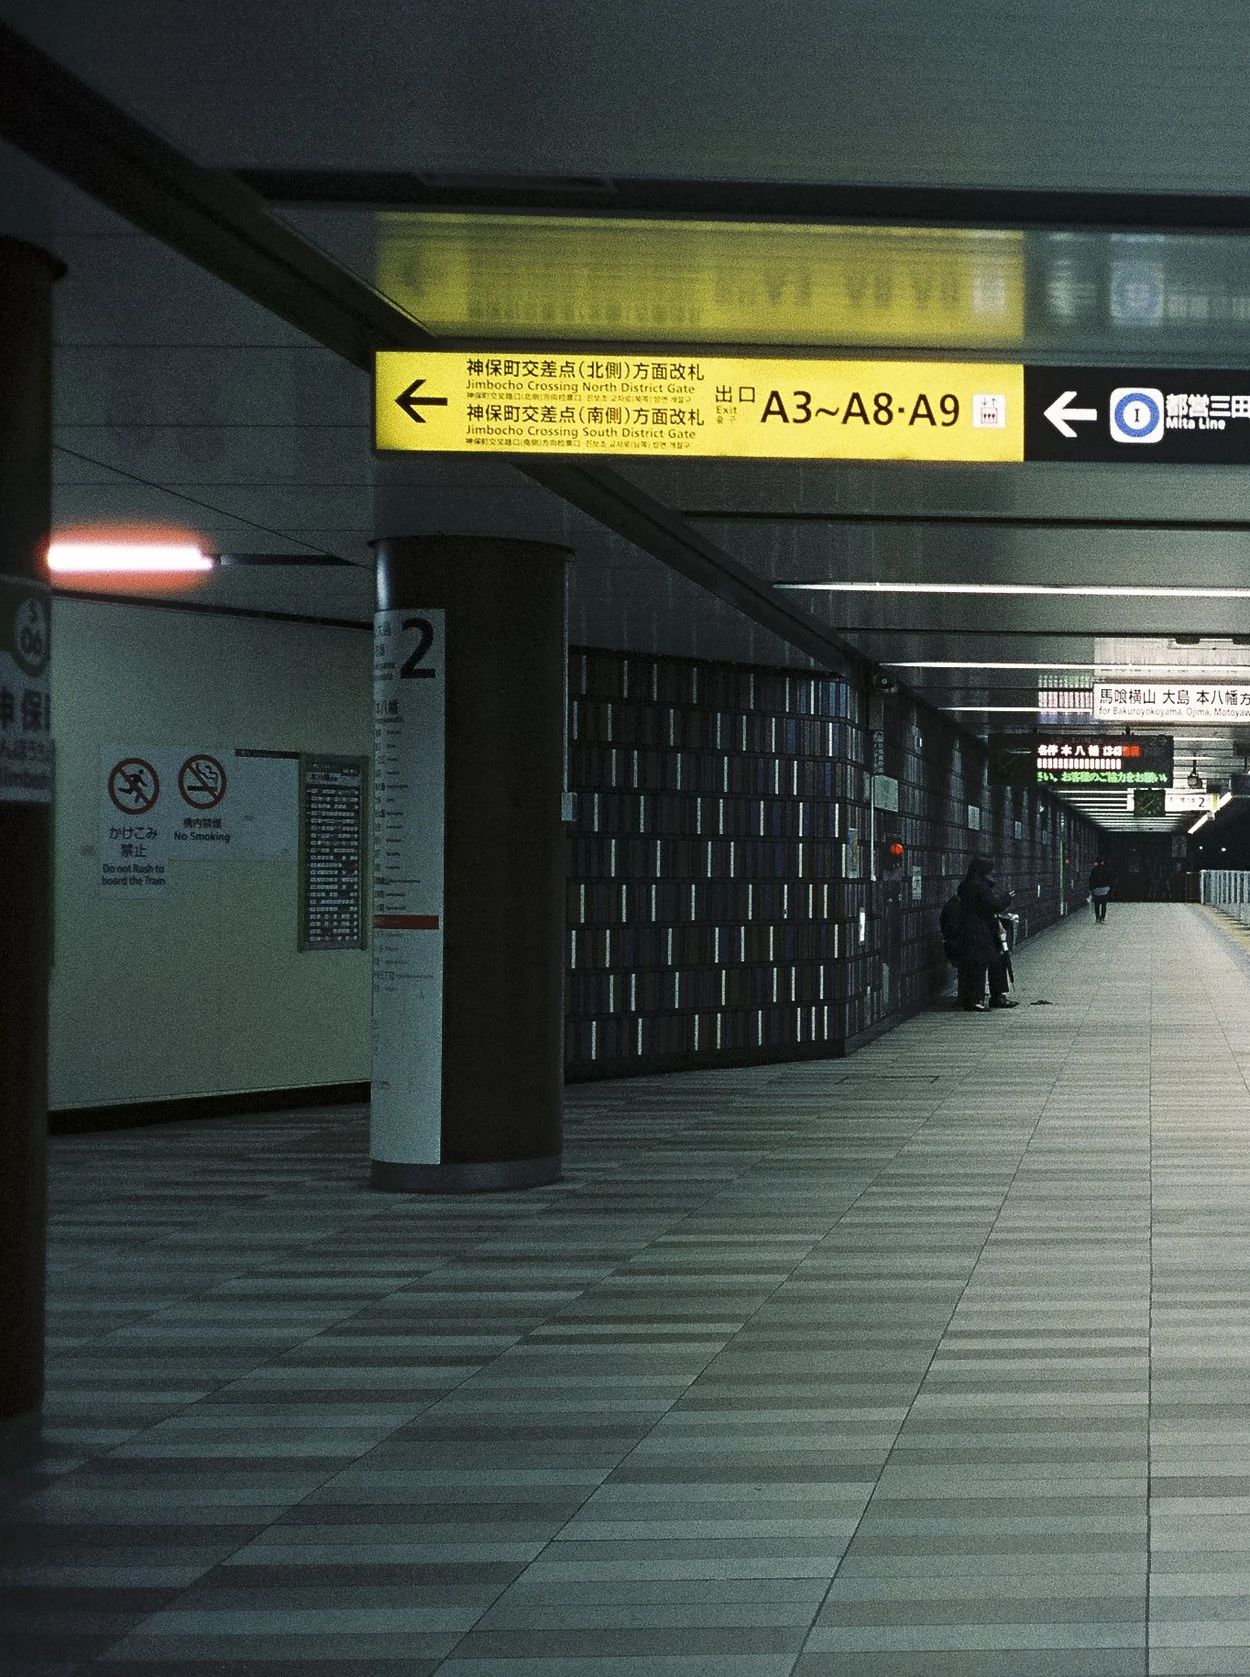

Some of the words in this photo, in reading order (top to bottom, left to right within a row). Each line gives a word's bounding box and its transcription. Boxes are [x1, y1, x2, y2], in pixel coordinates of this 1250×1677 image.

[466, 358, 705, 381] 神保町交差点(北側)方面改札
[466, 379, 524, 391] Jimbocho
[527, 381, 579, 394] Crossing
[582, 382, 617, 392] North
[621, 382, 663, 393] District
[667, 383, 695, 394] Gate
[715, 385, 755, 403] 出口
[466, 404, 705, 426] 神保町交差点(南側)方面改札
[716, 405, 737, 414] Exit
[1132, 408, 1141, 422] I
[1166, 417, 1198, 430] Mita
[1199, 418, 1226, 431] Line
[466, 424, 524, 436] Jimbocho
[527, 426, 579, 439] Crossing
[582, 427, 618, 437] South
[622, 427, 664, 439] District
[668, 429, 696, 440] Gate
[401, 618, 436, 679] 2
[1099, 688, 1156, 705] 馬喰横山
[1162, 690, 1190, 706] 大島
[1099, 707, 1111, 716] for
[1198, 797, 1205, 808] 2
[109, 827, 158, 840] かけこみ
[174, 832, 188, 841] No
[190, 832, 231, 843] Smoking
[120, 844, 147, 858] 禁止
[102, 864, 116, 874] Do
[117, 865, 132, 874] not
[133, 864, 154, 874] Rush
[155, 864, 165, 874] to
[102, 876, 128, 886] board
[129, 876, 143, 886] the
[145, 876, 166, 886] Train
